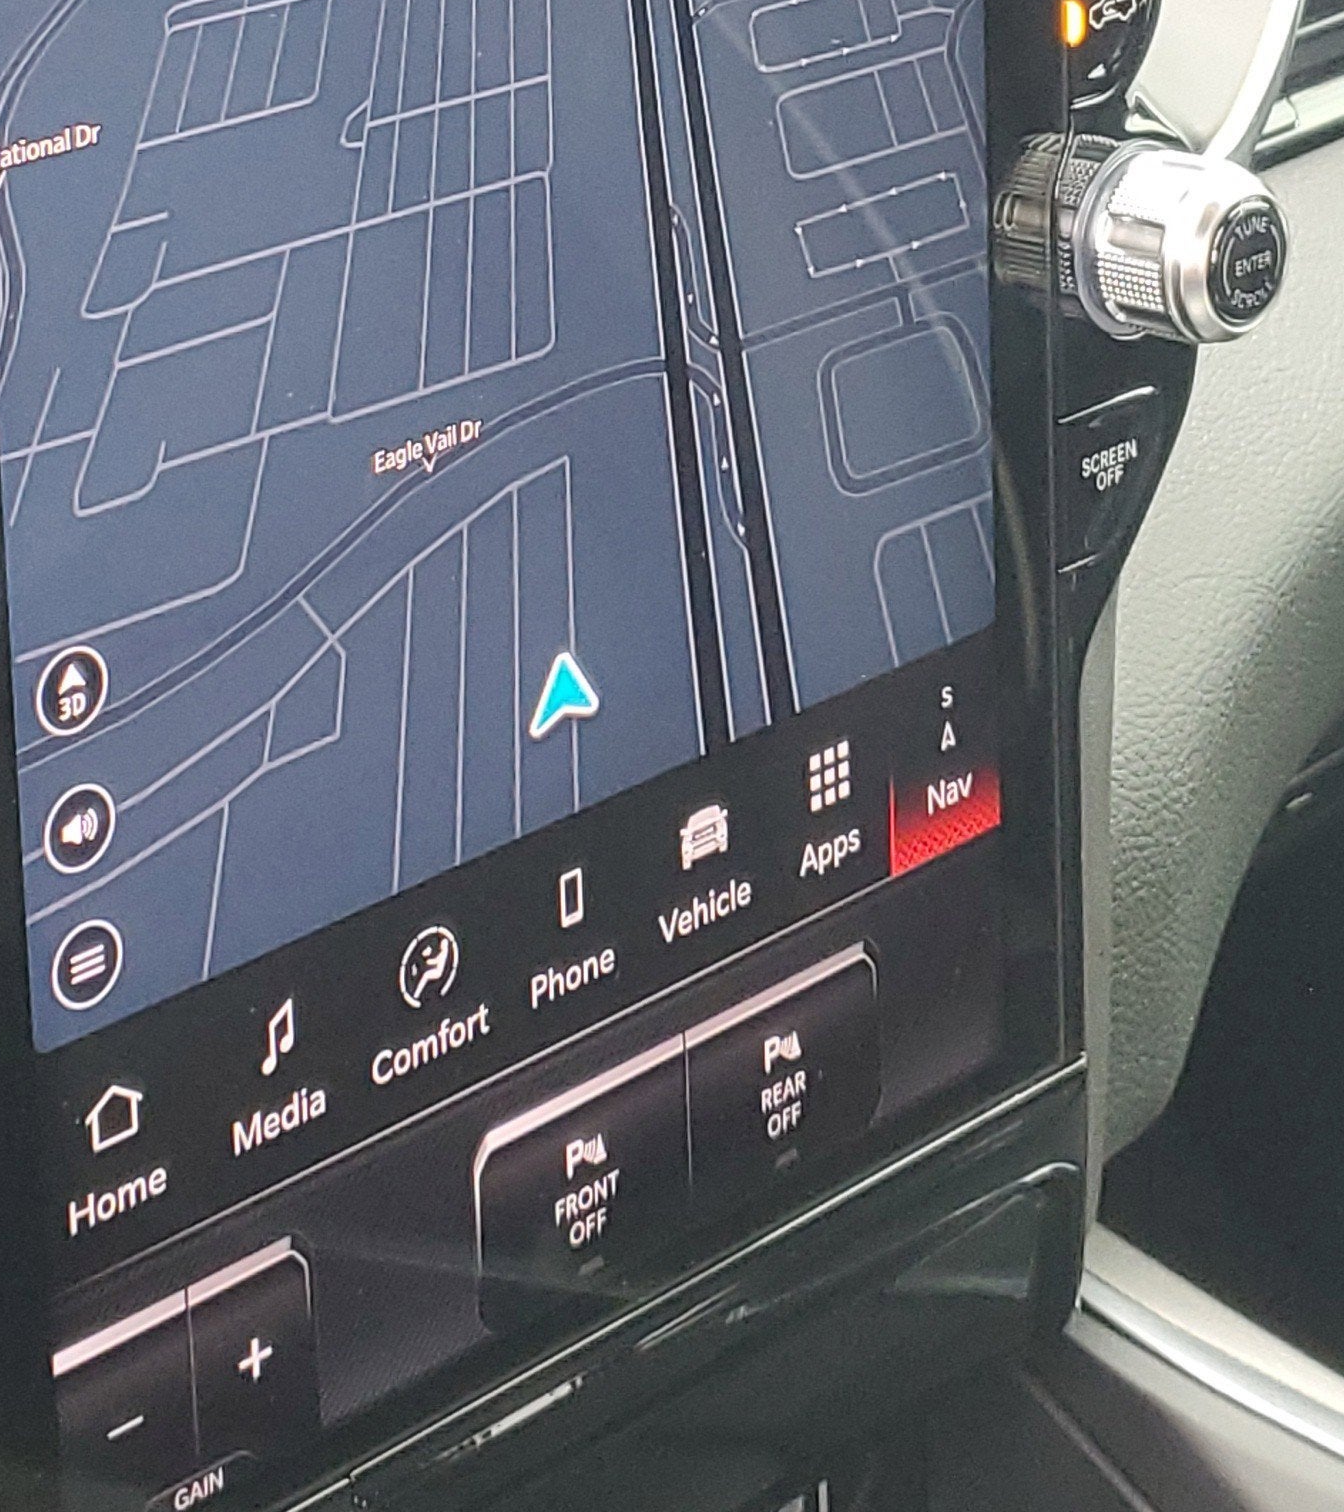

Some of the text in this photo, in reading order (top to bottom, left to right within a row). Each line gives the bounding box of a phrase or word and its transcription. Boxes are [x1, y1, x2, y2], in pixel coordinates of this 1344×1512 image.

[74, 123, 102, 148] Dr
[372, 419, 482, 474] Eagle Vail Dr
[1081, 438, 1138, 478] SCREEN
[1095, 463, 1125, 491] OFF
[58, 691, 87, 722] 3D
[927, 771, 973, 816] Nav
[798, 826, 861, 878] Apps
[658, 878, 752, 943] Vehicle
[530, 946, 616, 1010] Phone
[370, 1003, 491, 1086] Comfort
[761, 1069, 807, 1115] REAR
[230, 1087, 327, 1157] Media
[766, 1100, 802, 1140] OFF
[66, 1167, 168, 1238] Home
[555, 1168, 620, 1228] FRONT
[568, 1207, 608, 1250] OFF
[174, 1466, 224, 1512] GAIN
